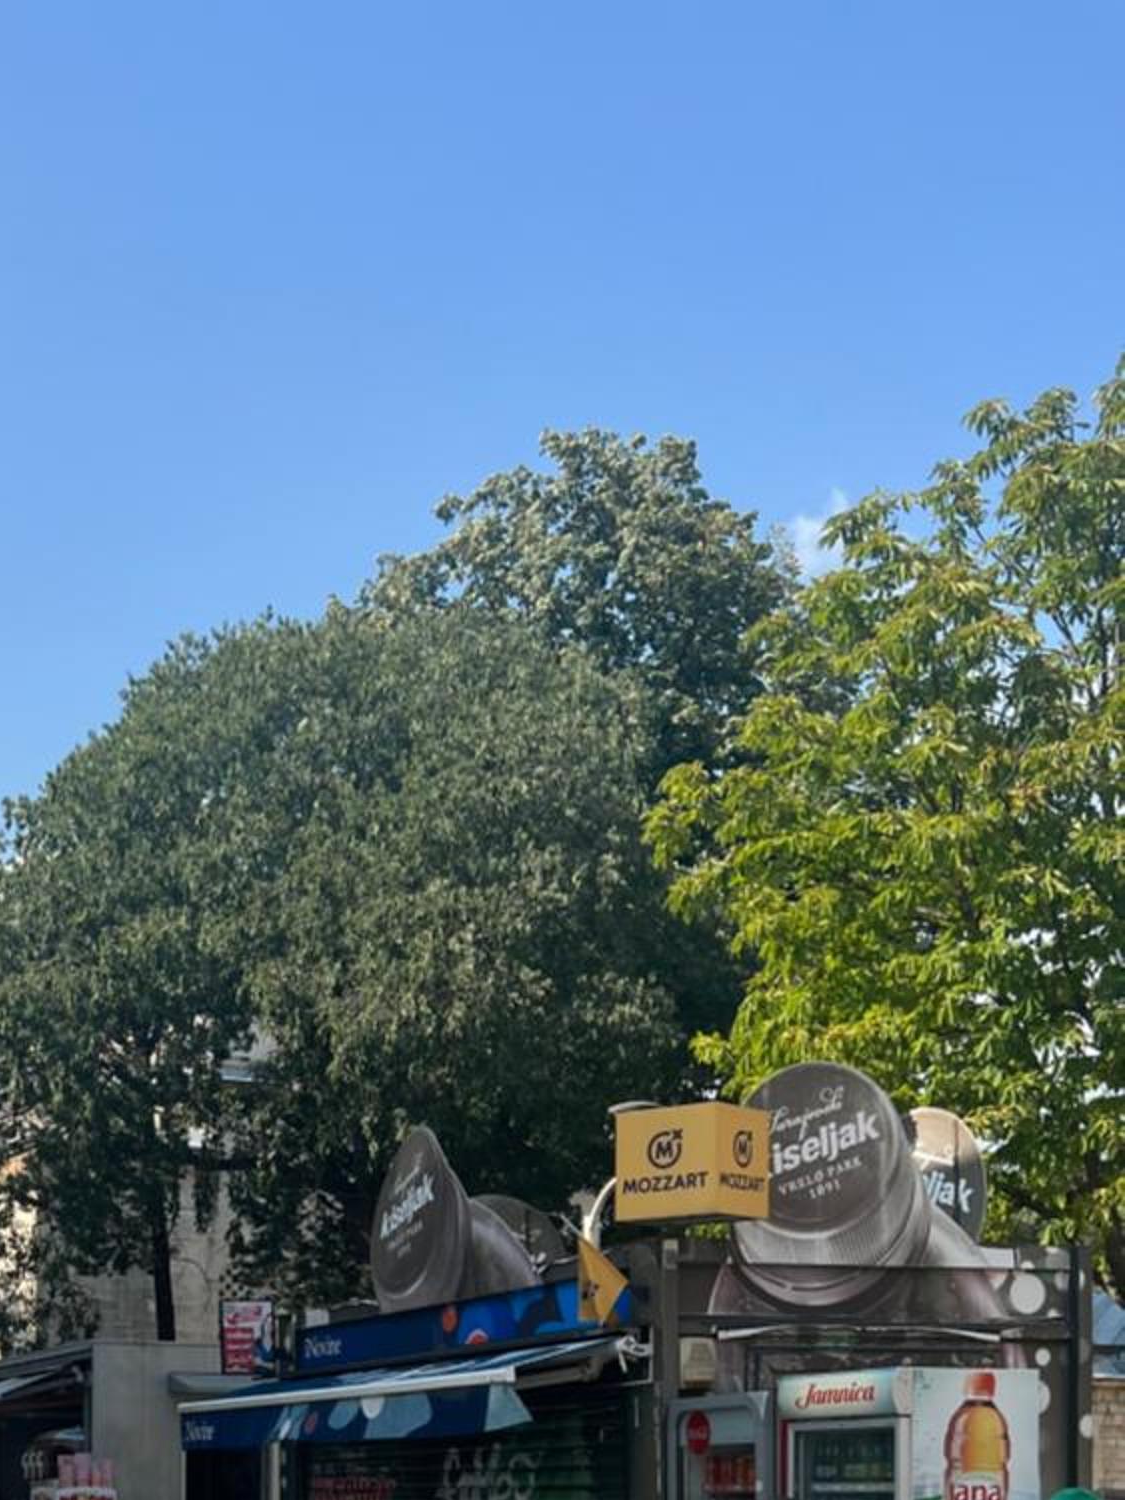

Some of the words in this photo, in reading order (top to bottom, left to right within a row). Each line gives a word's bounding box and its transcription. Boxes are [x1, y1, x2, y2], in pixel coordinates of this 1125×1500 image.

[768, 1110, 879, 1178] iseljak
[827, 1156, 863, 1178] PARK
[623, 1171, 708, 1195] MOZZART
